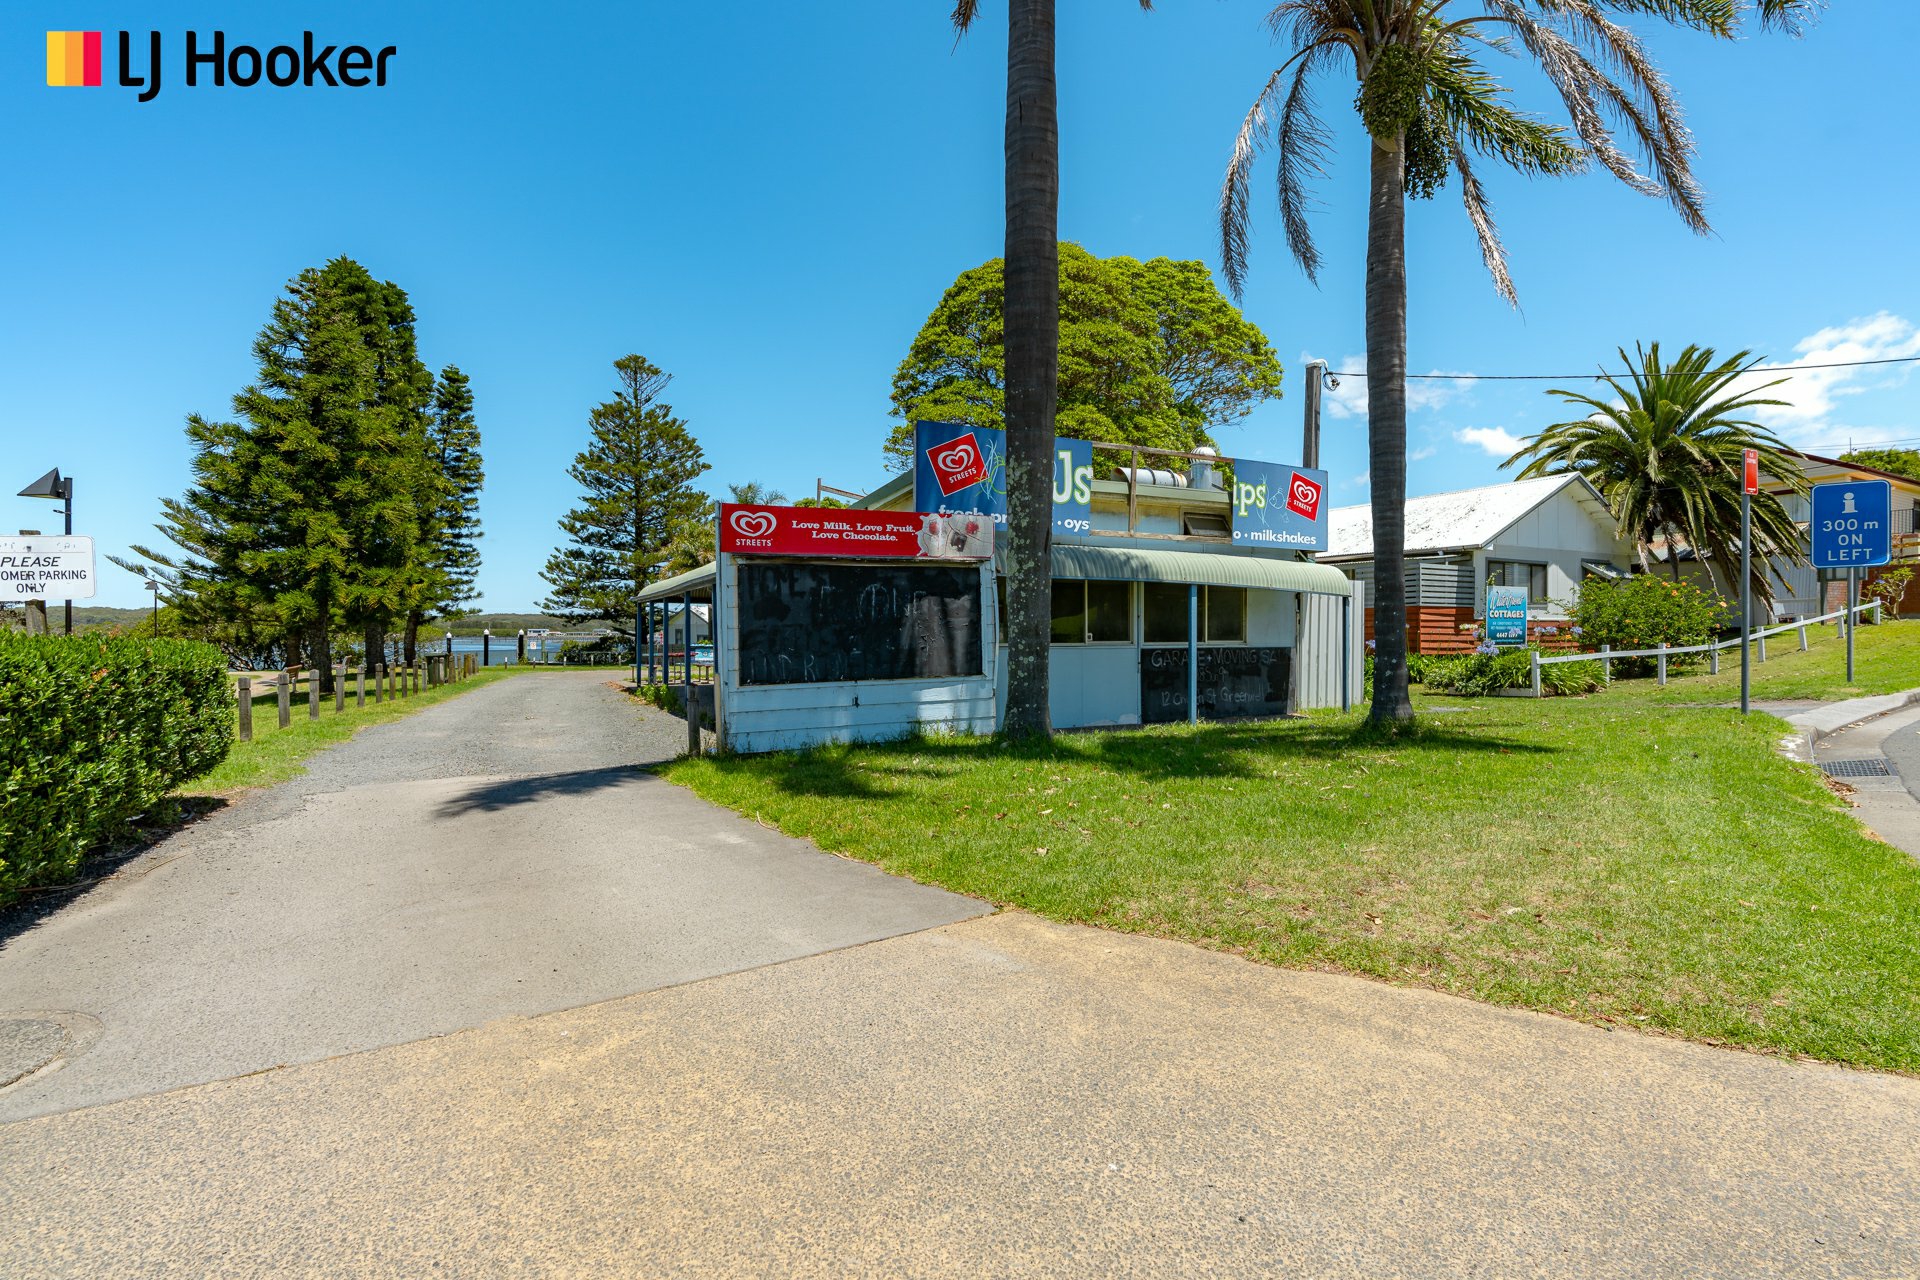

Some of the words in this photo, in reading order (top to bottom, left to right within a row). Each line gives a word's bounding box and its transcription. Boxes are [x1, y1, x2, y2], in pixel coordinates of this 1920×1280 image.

[949, 467, 977, 484] STREETS
[1293, 499, 1312, 512] STREETS
[792, 520, 820, 529] Love
[823, 521, 854, 530] Milk.
[856, 523, 883, 531] Love
[886, 524, 916, 533] Fruit.
[1822, 519, 1858, 532] 300
[1864, 521, 1879, 530] m
[811, 530, 840, 539] Love
[843, 531, 899, 541] Chocolate.
[1251, 530, 1317, 545] milkshakes
[1838, 534, 1863, 546] ON
[735, 538, 773, 547] STREETS
[1828, 548, 1873, 561] LEFT
[0, 556, 61, 568] PLEASE
[0, 570, 36, 581] OMER
[39, 569, 87, 580] PARKING
[16, 582, 47, 593] ONLY
[1490, 610, 1525, 619] COTTAGES
[1151, 649, 1206, 667] GARAE
